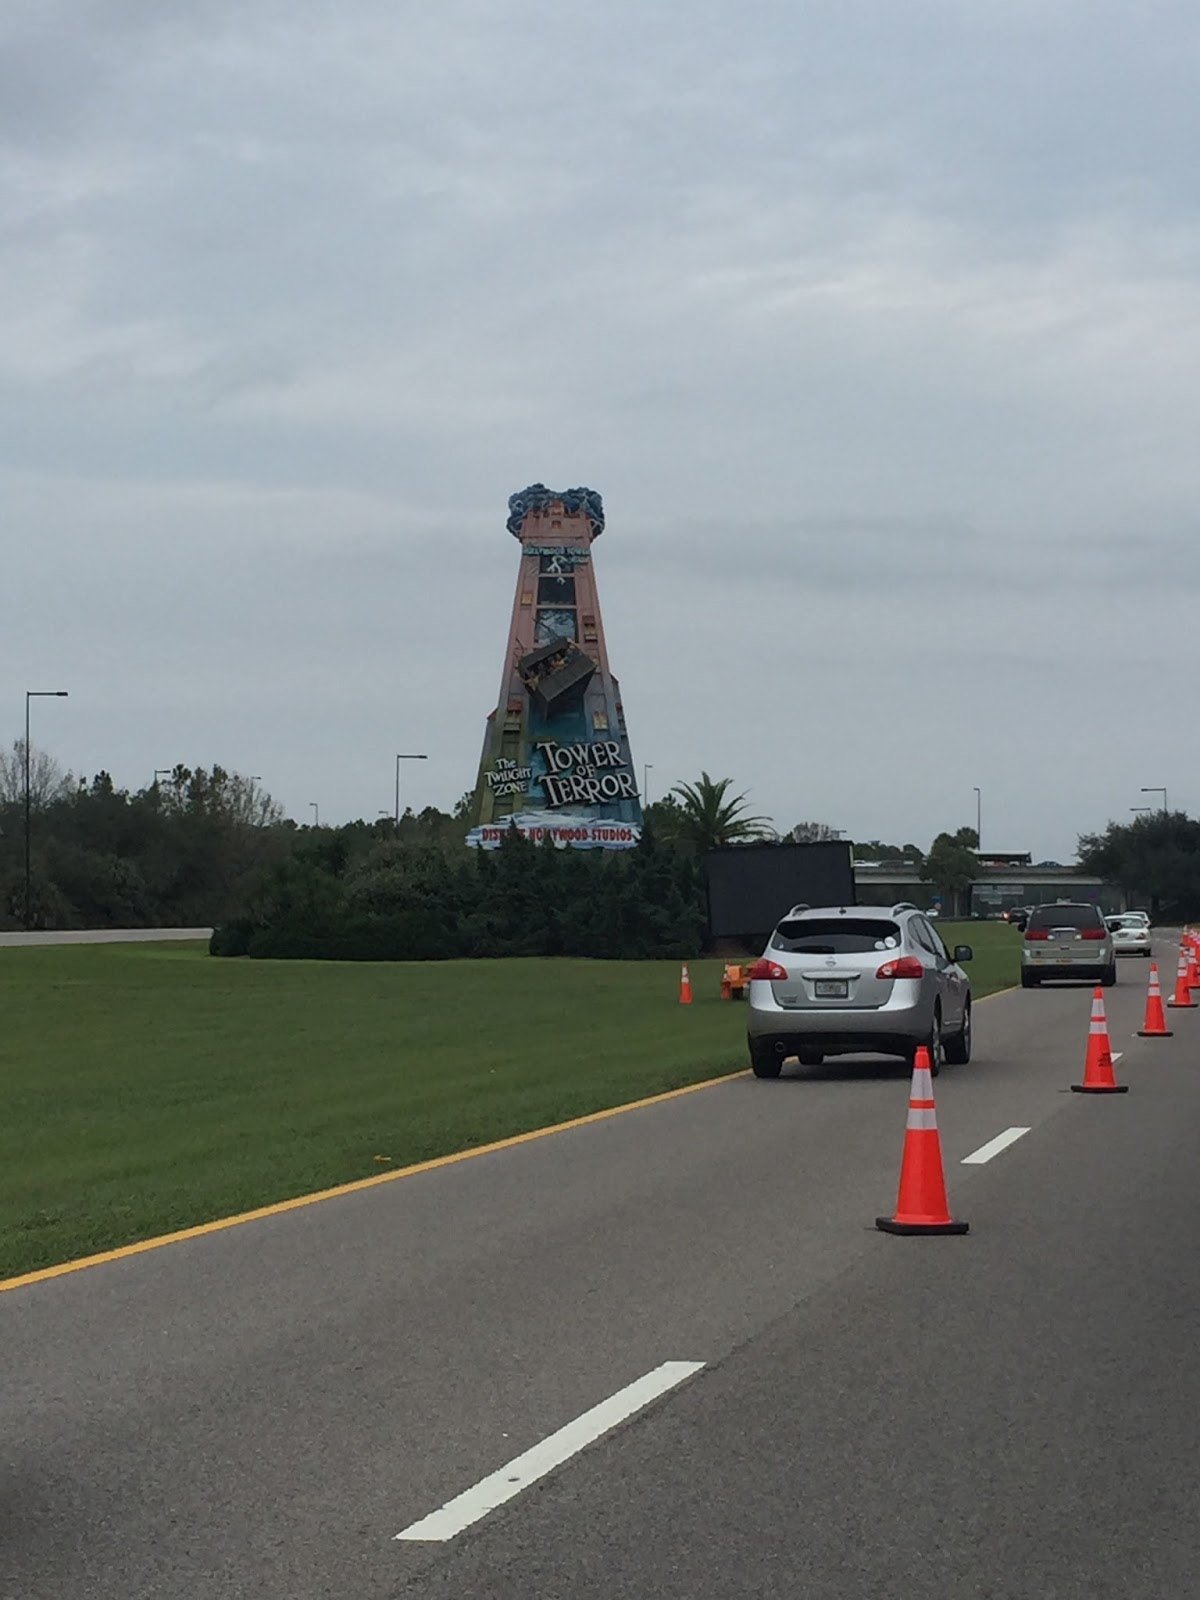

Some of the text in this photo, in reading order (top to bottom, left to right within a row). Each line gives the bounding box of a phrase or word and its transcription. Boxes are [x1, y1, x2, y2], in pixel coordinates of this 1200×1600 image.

[495, 758, 517, 769] The
[538, 741, 628, 773] TOWER
[484, 768, 531, 786] TWILIGHT
[576, 764, 596, 777] OF
[493, 781, 527, 797] ZONE
[538, 773, 639, 807] TERROR
[591, 828, 632, 841] STUDIOS
